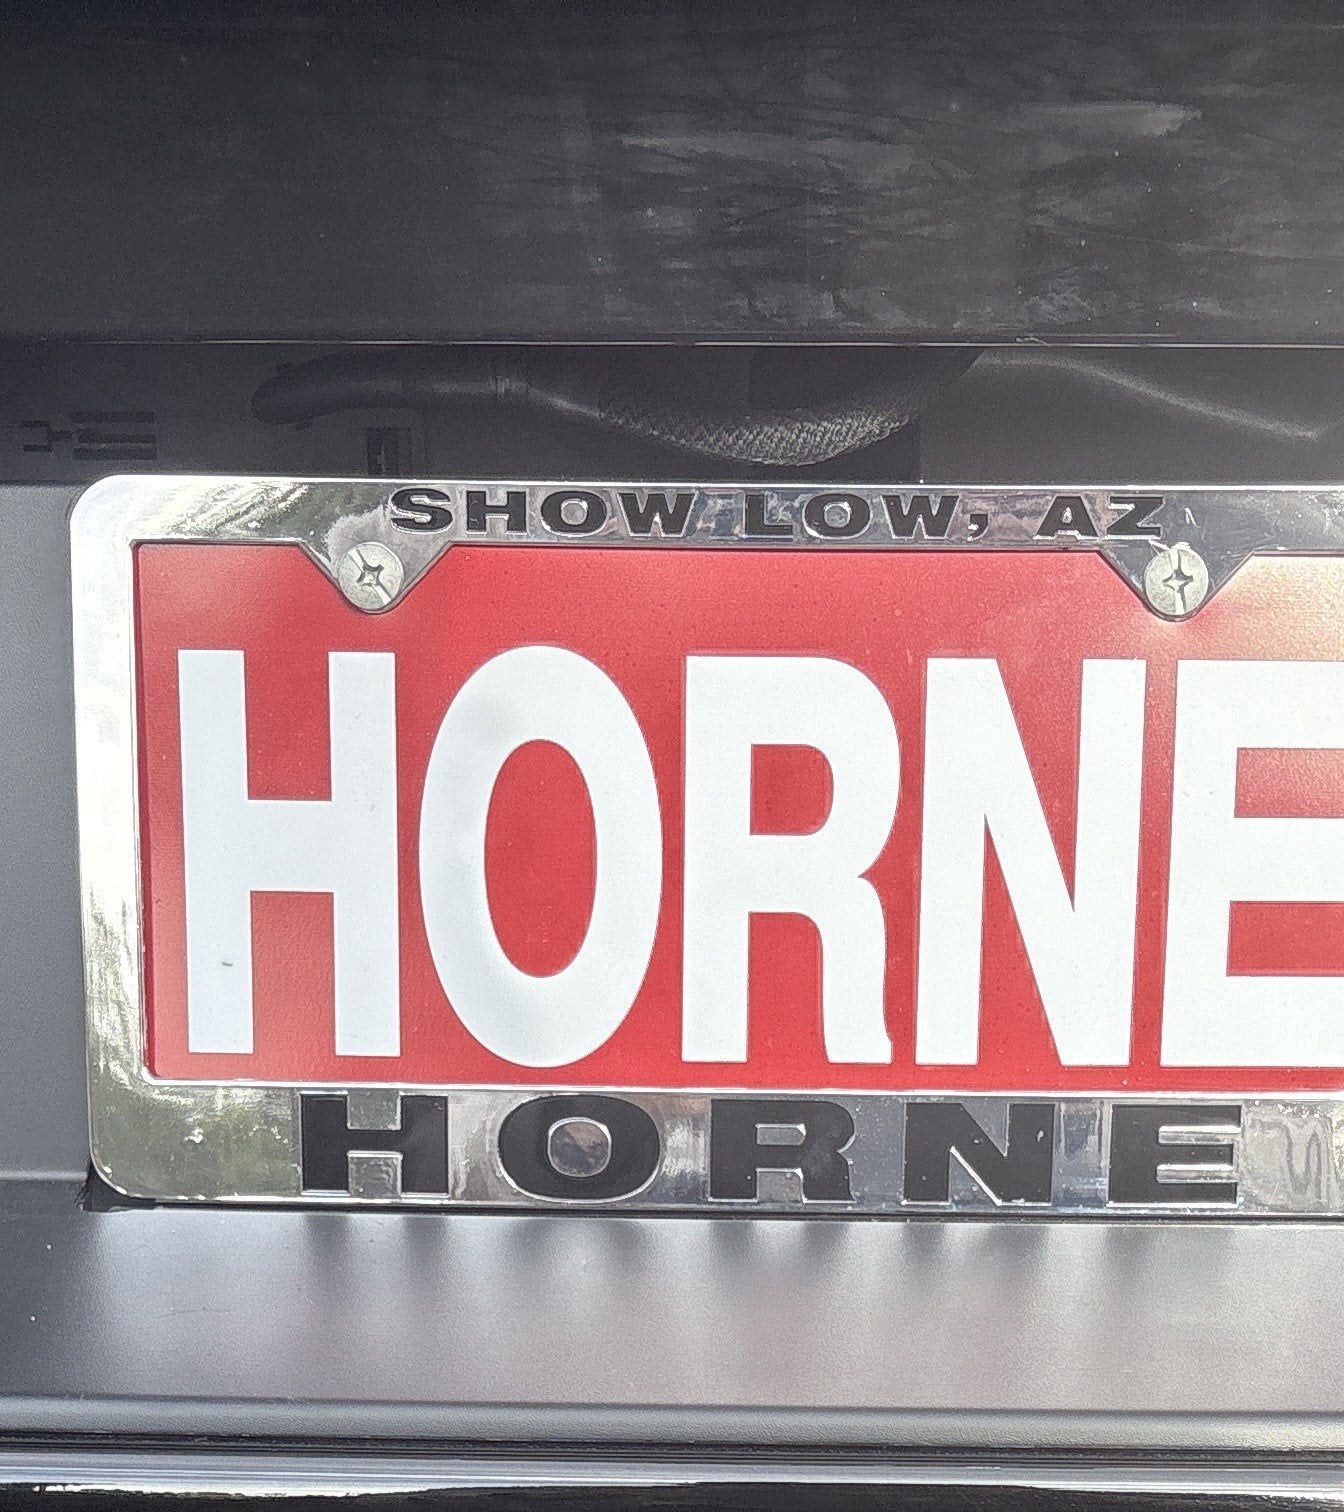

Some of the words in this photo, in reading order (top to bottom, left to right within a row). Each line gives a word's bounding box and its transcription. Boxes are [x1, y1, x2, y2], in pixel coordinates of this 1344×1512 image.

[390, 487, 698, 537] SHOW
[742, 492, 989, 540] LOW,
[1033, 494, 1164, 540] AZ
[297, 1092, 1242, 1205] HORNE
